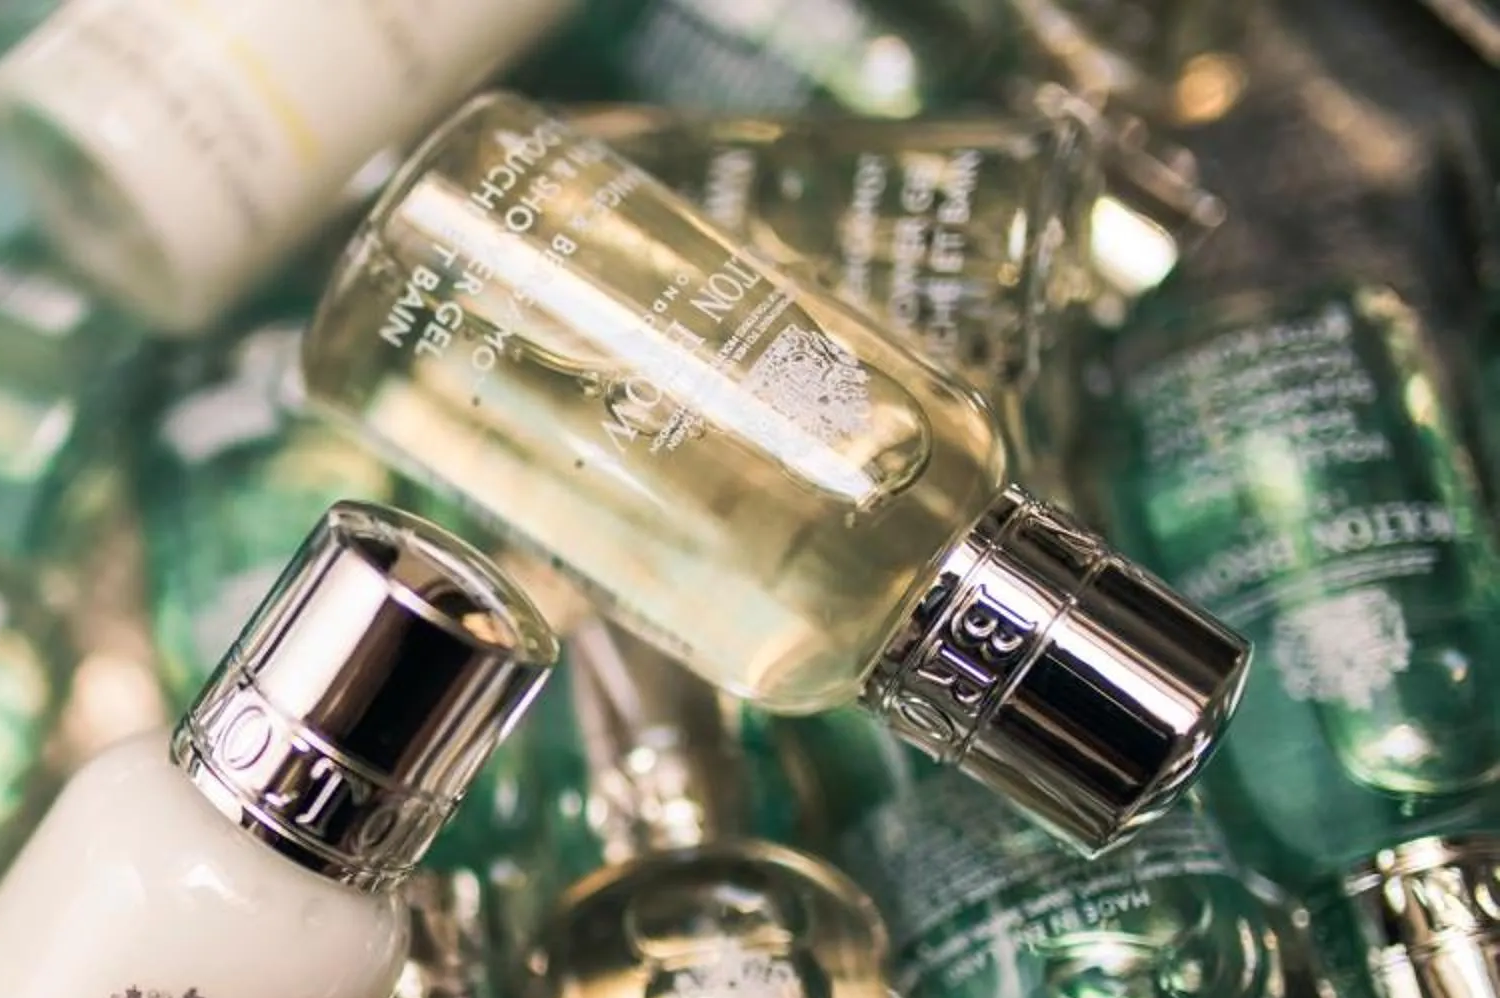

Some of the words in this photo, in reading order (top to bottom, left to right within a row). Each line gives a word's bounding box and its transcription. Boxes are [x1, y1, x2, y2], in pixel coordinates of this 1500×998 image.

[454, 174, 562, 296] SHOER
[378, 264, 441, 348] BAIN
[414, 300, 465, 357] GEL
[894, 582, 1040, 744] BRO
